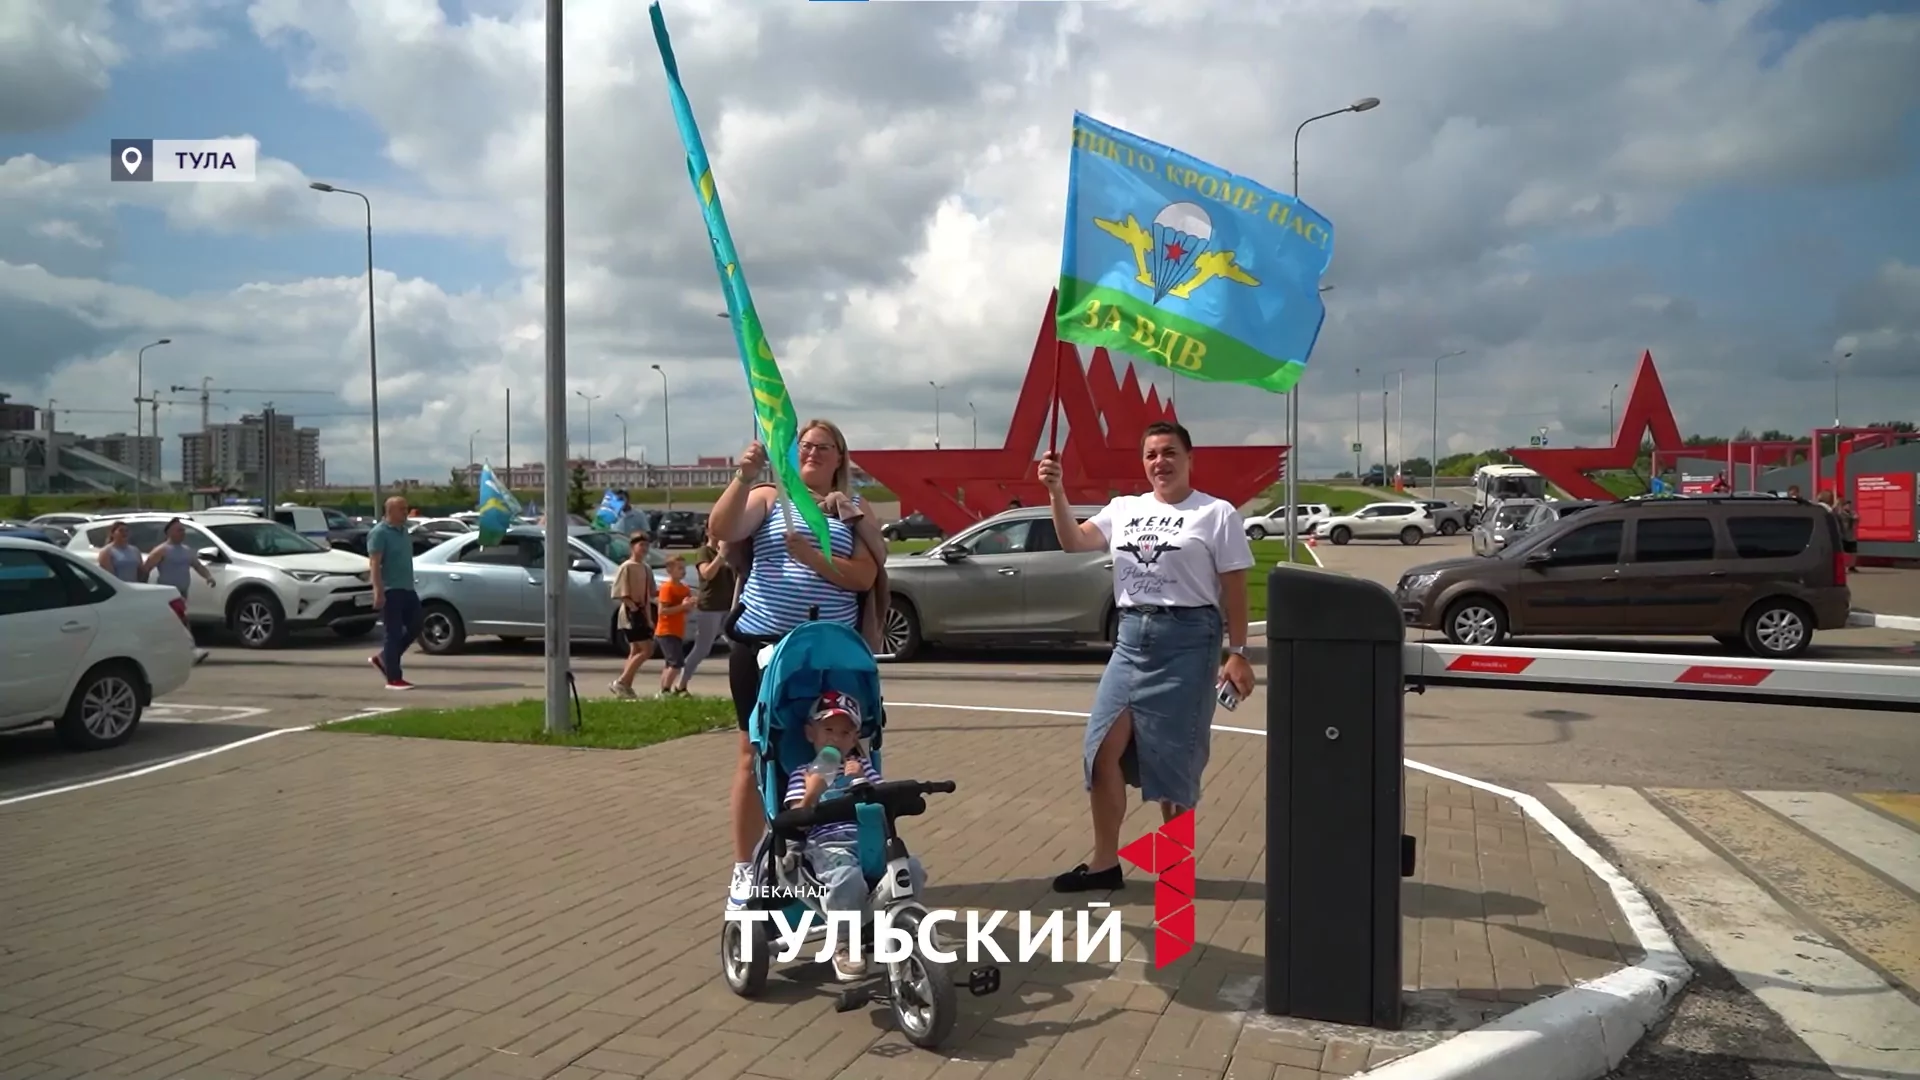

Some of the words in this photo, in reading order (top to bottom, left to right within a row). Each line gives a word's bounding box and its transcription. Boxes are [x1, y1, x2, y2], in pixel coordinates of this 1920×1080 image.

[1165, 163, 1264, 214] КРОМЕ
[1267, 202, 1329, 250] НАС!
[1082, 299, 1121, 332] ЗА
[1130, 314, 1207, 371] ВДВ
[1124, 516, 1184, 528] ЖЕНА
